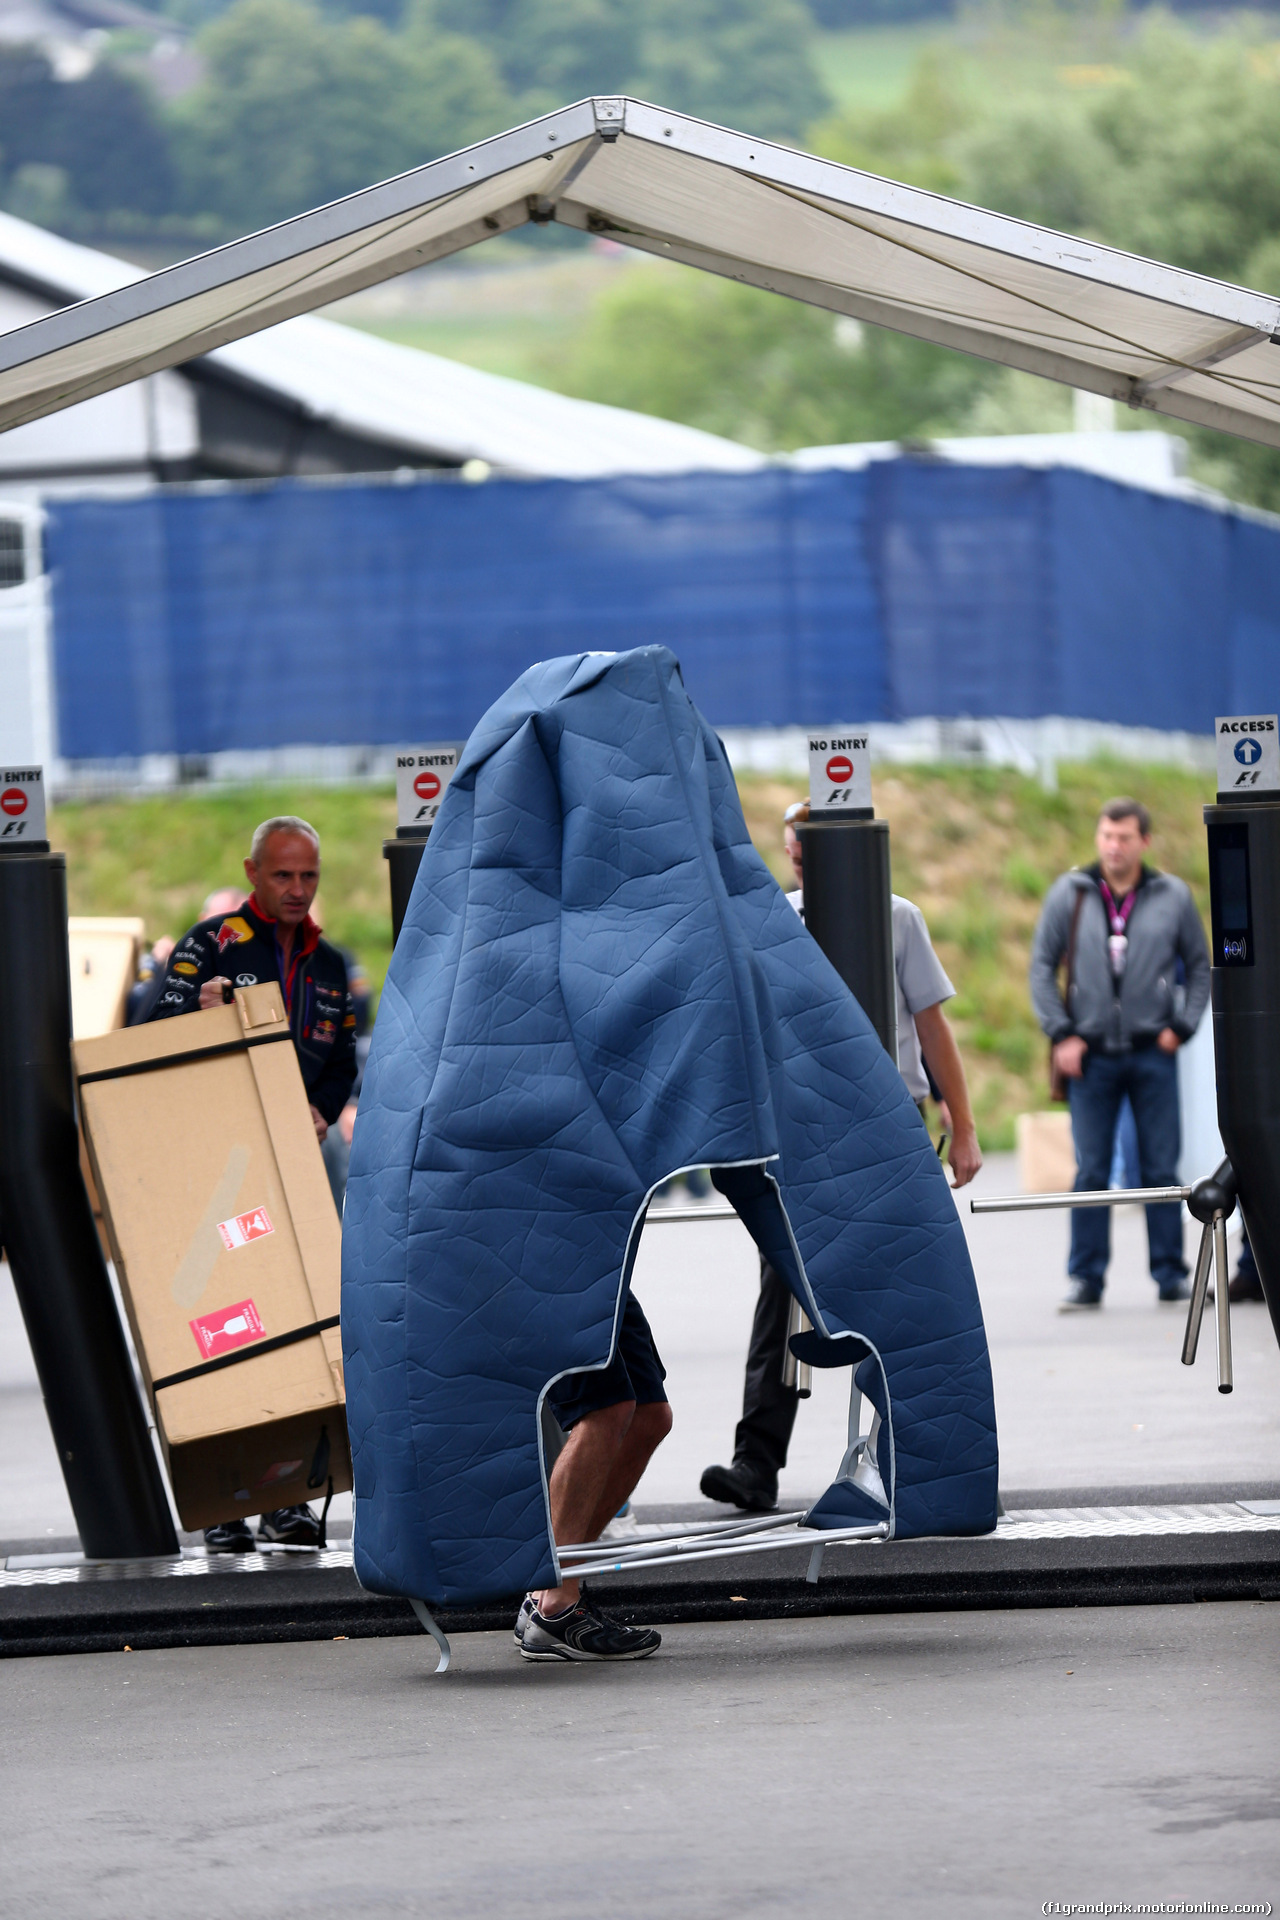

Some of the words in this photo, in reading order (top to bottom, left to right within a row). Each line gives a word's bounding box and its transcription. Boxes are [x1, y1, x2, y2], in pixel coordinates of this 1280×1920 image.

[1220, 721, 1275, 733] ACCESS
[810, 740, 828, 751] NO
[831, 738, 868, 750] ENTRY
[397, 756, 415, 767] NO
[418, 754, 455, 766] ENTRY
[4, 770, 42, 782] ENTRY
[1234, 770, 1261, 785] F1
[827, 788, 853, 802] F1
[242, 1307, 256, 1334] FRAGILE
